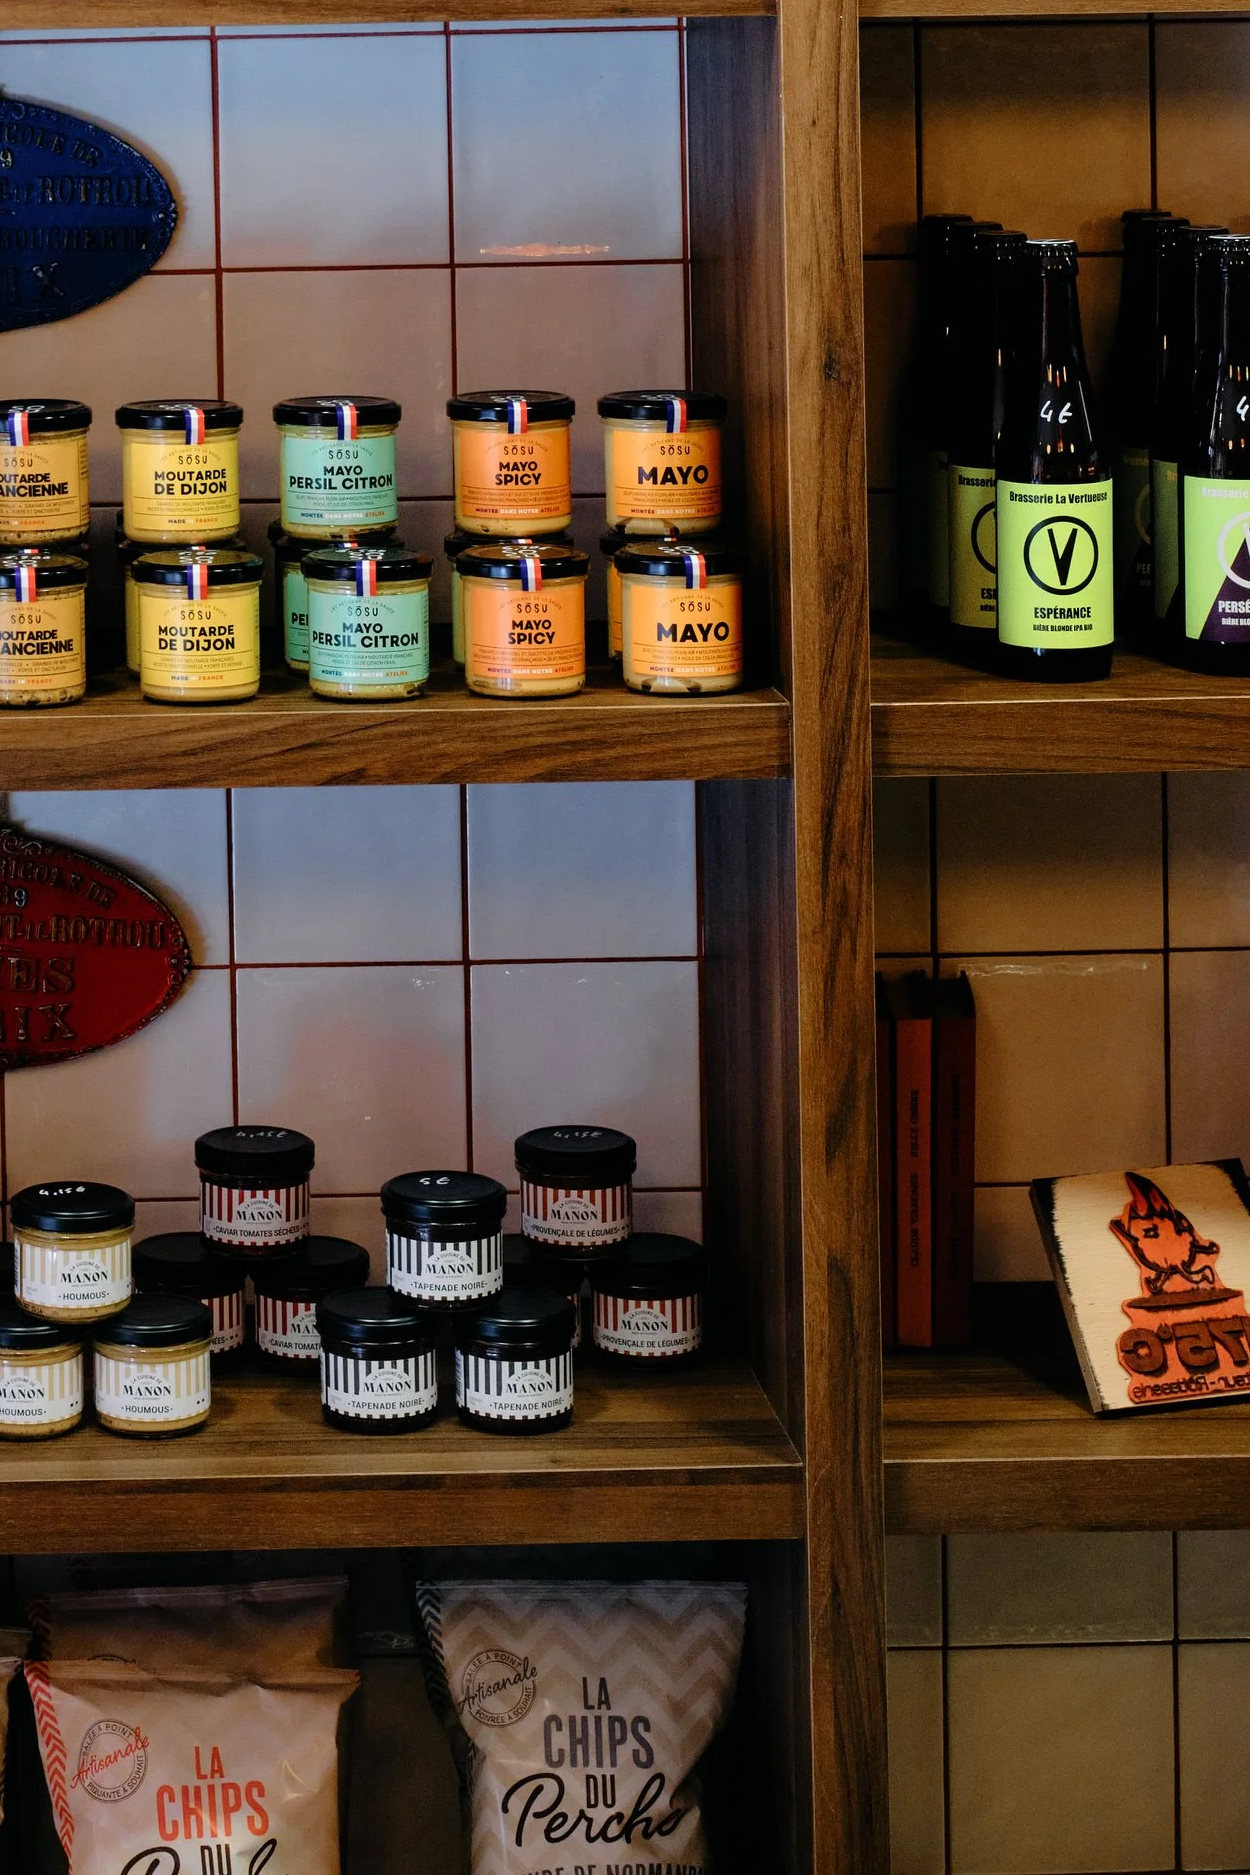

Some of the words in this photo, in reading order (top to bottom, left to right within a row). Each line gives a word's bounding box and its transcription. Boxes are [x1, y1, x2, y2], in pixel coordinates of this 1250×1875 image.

[323, 465, 363, 476] MAYO
[499, 461, 538, 471] MAYO
[154, 469, 227, 481] MOUTARDE
[495, 473, 542, 486] SPICY
[637, 465, 709, 485] MAYO
[154, 483, 174, 495] DE
[180, 481, 227, 495] DIJON
[290, 475, 337, 490] PERSIL
[342, 474, 392, 489] CITRON
[1009, 491, 1053, 504] Brasserie
[1055, 491, 1066, 504] La
[1068, 491, 1107, 504] Vertueuse
[1034, 606, 1091, 619] ESPÉRANCE
[158, 625, 234, 637] MOUTARDE
[342, 623, 382, 633] MAYO
[512, 619, 551, 631] MAYO
[508, 632, 555, 645] SPICY
[657, 621, 730, 643] MAYO
[158, 638, 178, 651] DE
[183, 637, 235, 651] DIJON
[312, 632, 357, 647] PERSIL
[361, 633, 418, 647] CITRON
[551, 1209, 597, 1220] MANON
[215, 1226, 238, 1236] CAVIAR
[240, 1229, 272, 1237] TOMATES
[576, 1229, 587, 1237] DE
[426, 1263, 473, 1274] MANON
[61, 1271, 108, 1284] MANON
[414, 1282, 459, 1291] TAPENADE
[461, 1281, 485, 1290] NOIRE
[63, 1291, 106, 1300] HOUMOUS
[0, 1408, 43, 1416] HOUMOUS
[458, 1656, 537, 1714] Artisanale
[582, 1677, 611, 1710] LA
[543, 1714, 654, 1768] CHIPS
[70, 1726, 150, 1789] Artisanale
[194, 1746, 225, 1779] LA
[586, 1774, 616, 1808] DU
[156, 1781, 269, 1841] CHIPS
